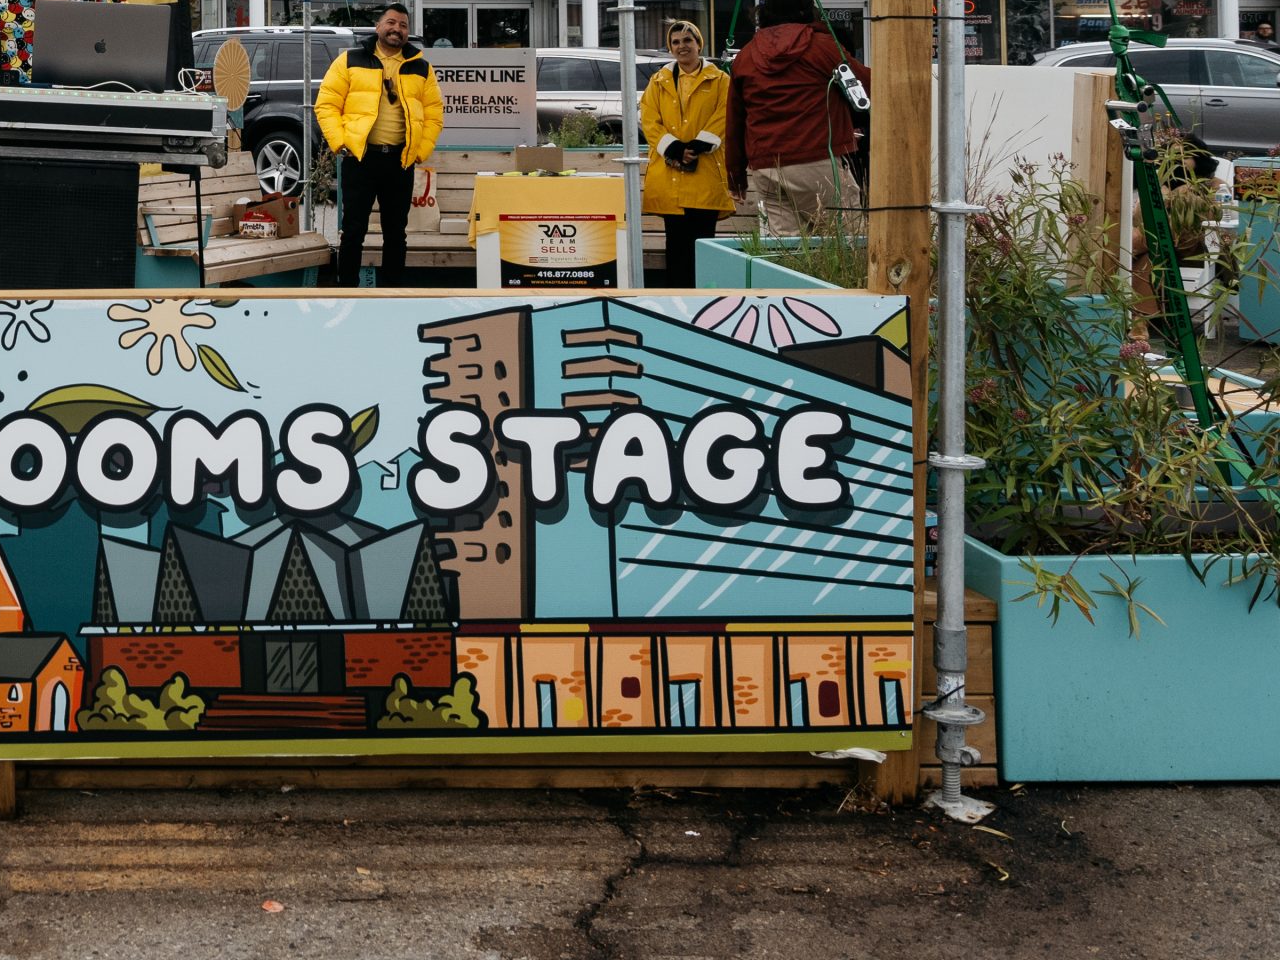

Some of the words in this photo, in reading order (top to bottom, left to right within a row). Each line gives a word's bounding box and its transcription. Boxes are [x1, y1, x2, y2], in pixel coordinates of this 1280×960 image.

[435, 69, 487, 83] GREEN
[490, 69, 526, 83] LINE
[445, 95, 469, 105] THE
[472, 95, 518, 105] BLANK:
[455, 105, 500, 114] HEIGHTS
[503, 105, 520, 114] IS...
[538, 224, 577, 238] RAD
[540, 245, 577, 254] SELLS
[537, 271, 595, 279] 416.877.0886
[407, 401, 855, 512] STAGE
